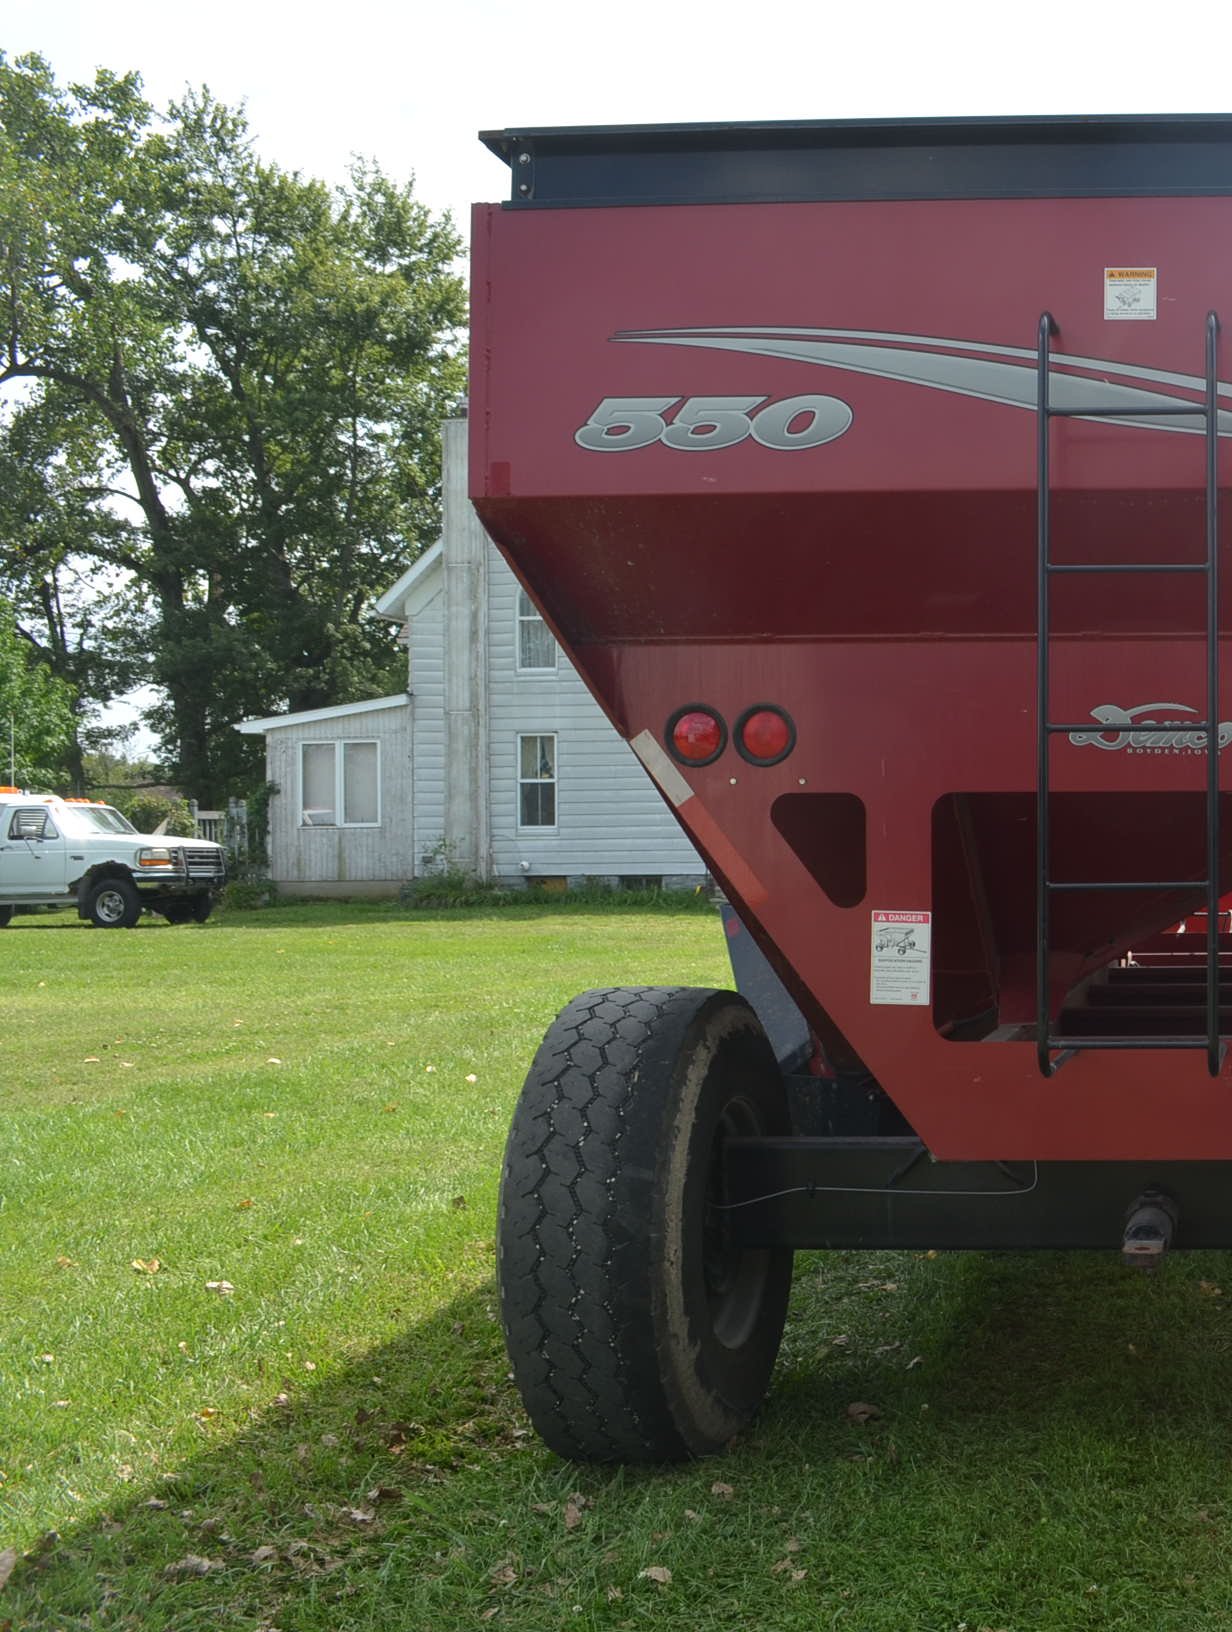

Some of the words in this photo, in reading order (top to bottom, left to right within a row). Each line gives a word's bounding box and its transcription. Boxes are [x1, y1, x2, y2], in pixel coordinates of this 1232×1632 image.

[1119, 271, 1153, 279] WARNING
[573, 393, 854, 452] 550
[888, 913, 924, 922] DANGER
